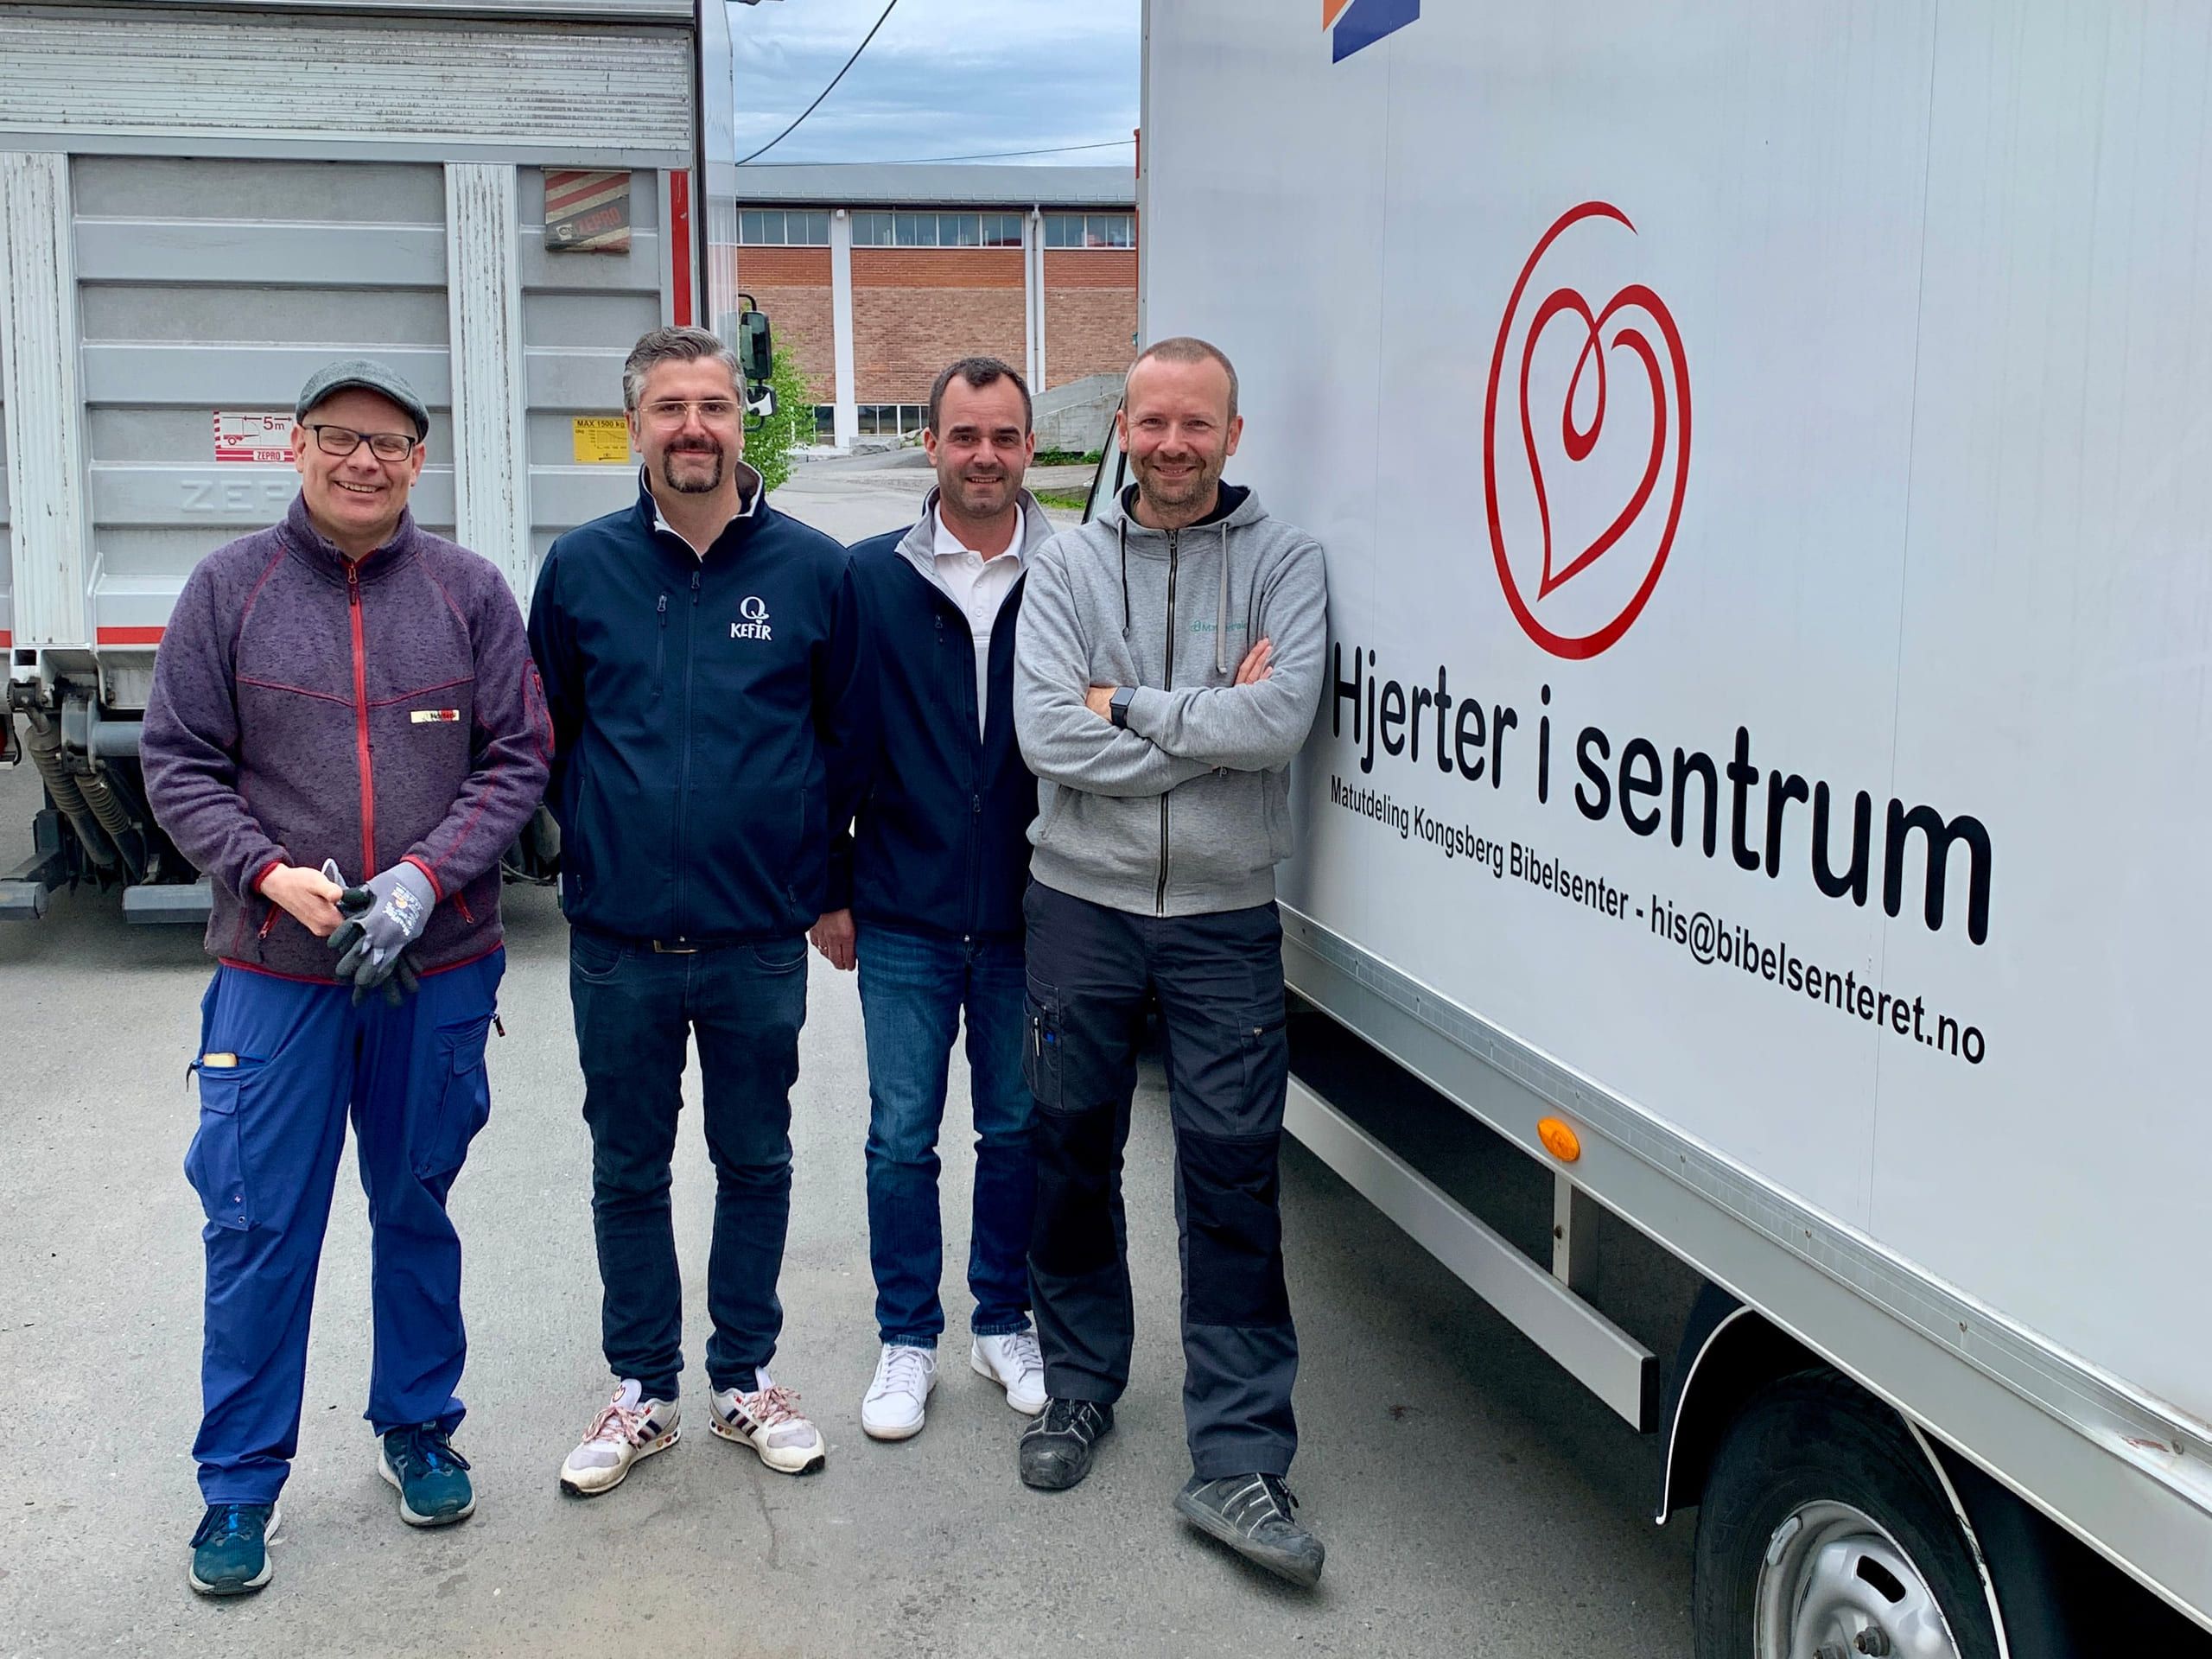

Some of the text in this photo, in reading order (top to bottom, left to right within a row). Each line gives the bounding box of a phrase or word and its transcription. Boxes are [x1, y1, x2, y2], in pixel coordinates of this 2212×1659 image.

[575, 207, 622, 235] ZEPRO
[257, 451, 281, 461] ZEPRO
[180, 480, 291, 512] ZEP
[740, 595, 770, 620] Q
[730, 620, 772, 640] KEFIR
[1332, 641, 1992, 946] Hjerter i sentrum
[1331, 774, 1409, 839] Matutdeling
[1414, 805, 1503, 879] Kongsberg
[1510, 842, 1629, 920] Bibelsenter
[1651, 894, 1986, 1065] his@bibelsenteret.no
